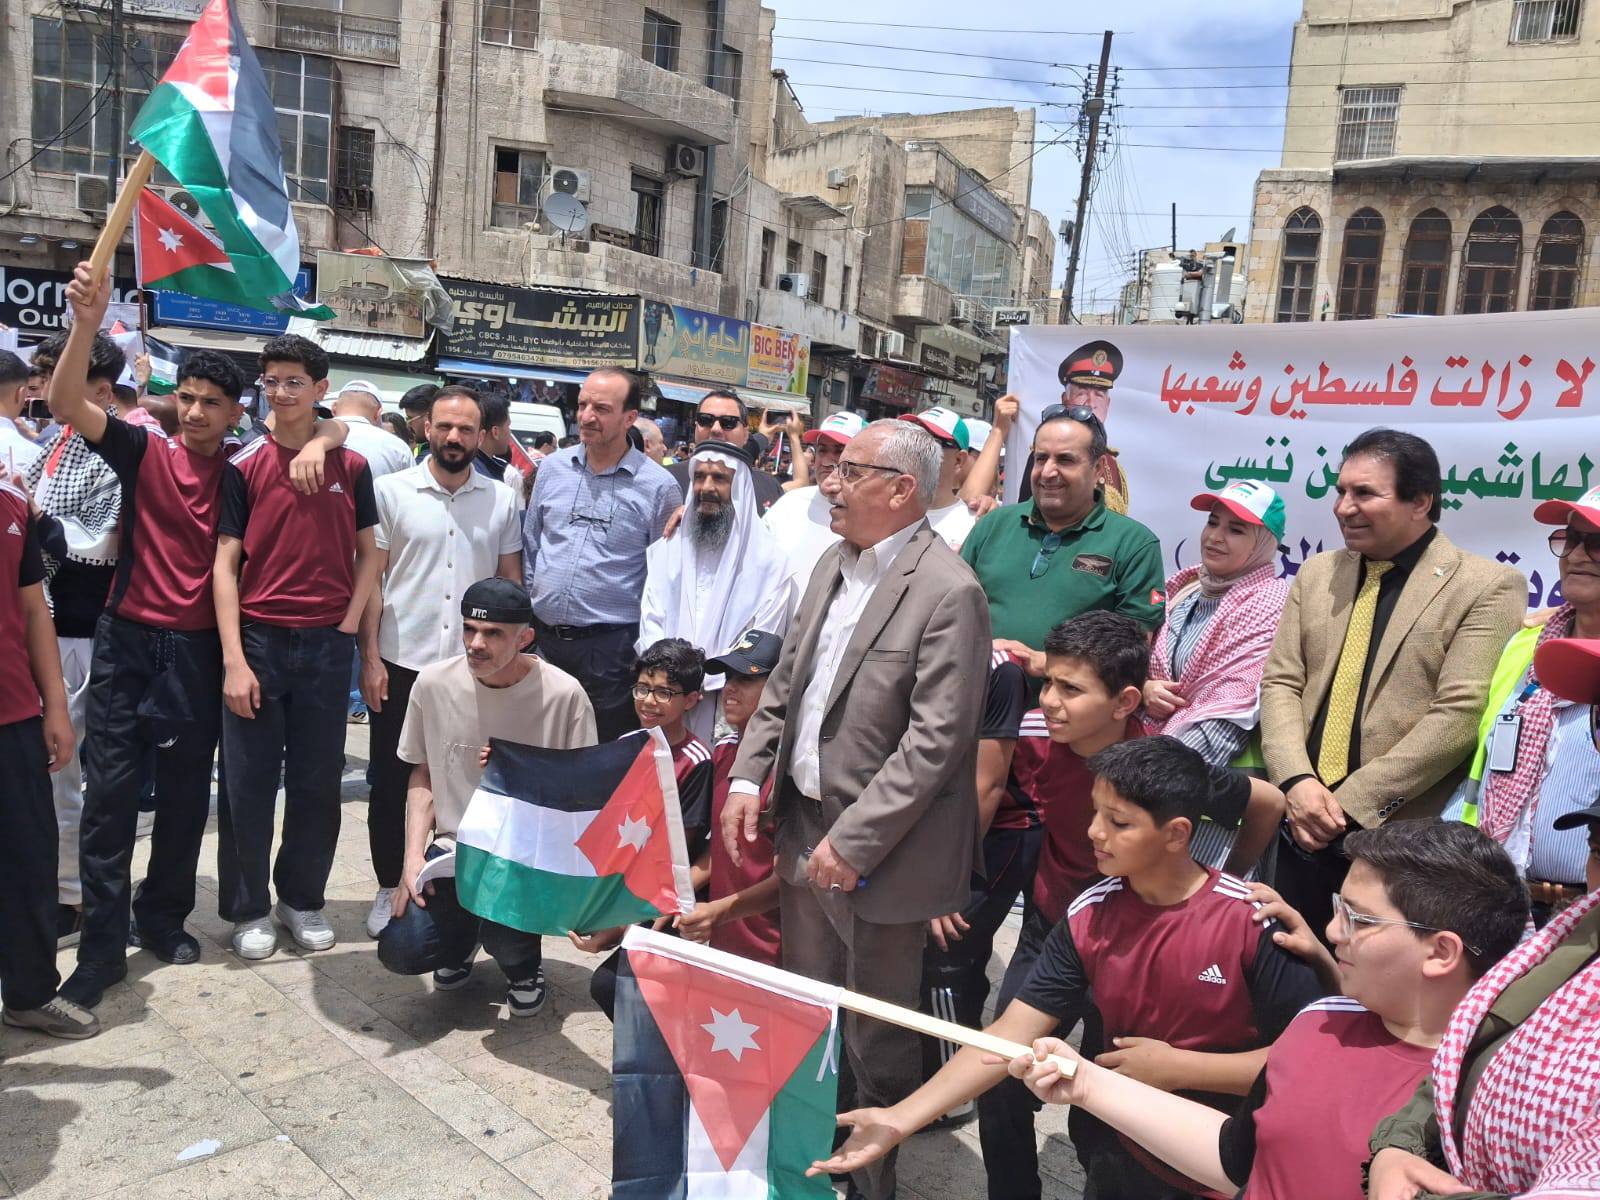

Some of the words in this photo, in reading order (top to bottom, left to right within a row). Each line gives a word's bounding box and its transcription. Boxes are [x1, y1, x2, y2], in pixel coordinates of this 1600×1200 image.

[452, 300, 628, 337] البيشاوي
[753, 334, 773, 356] BIG
[774, 339, 795, 361] BEN
[1160, 350, 1263, 416] وشعبها
[1270, 351, 1419, 420] فلسطين
[1430, 354, 1533, 421] زالت
[1555, 356, 1596, 408] لا
[1204, 435, 1294, 491] ننسى
[470, 607, 488, 619] NYC
[1198, 974, 1225, 984] adidas
